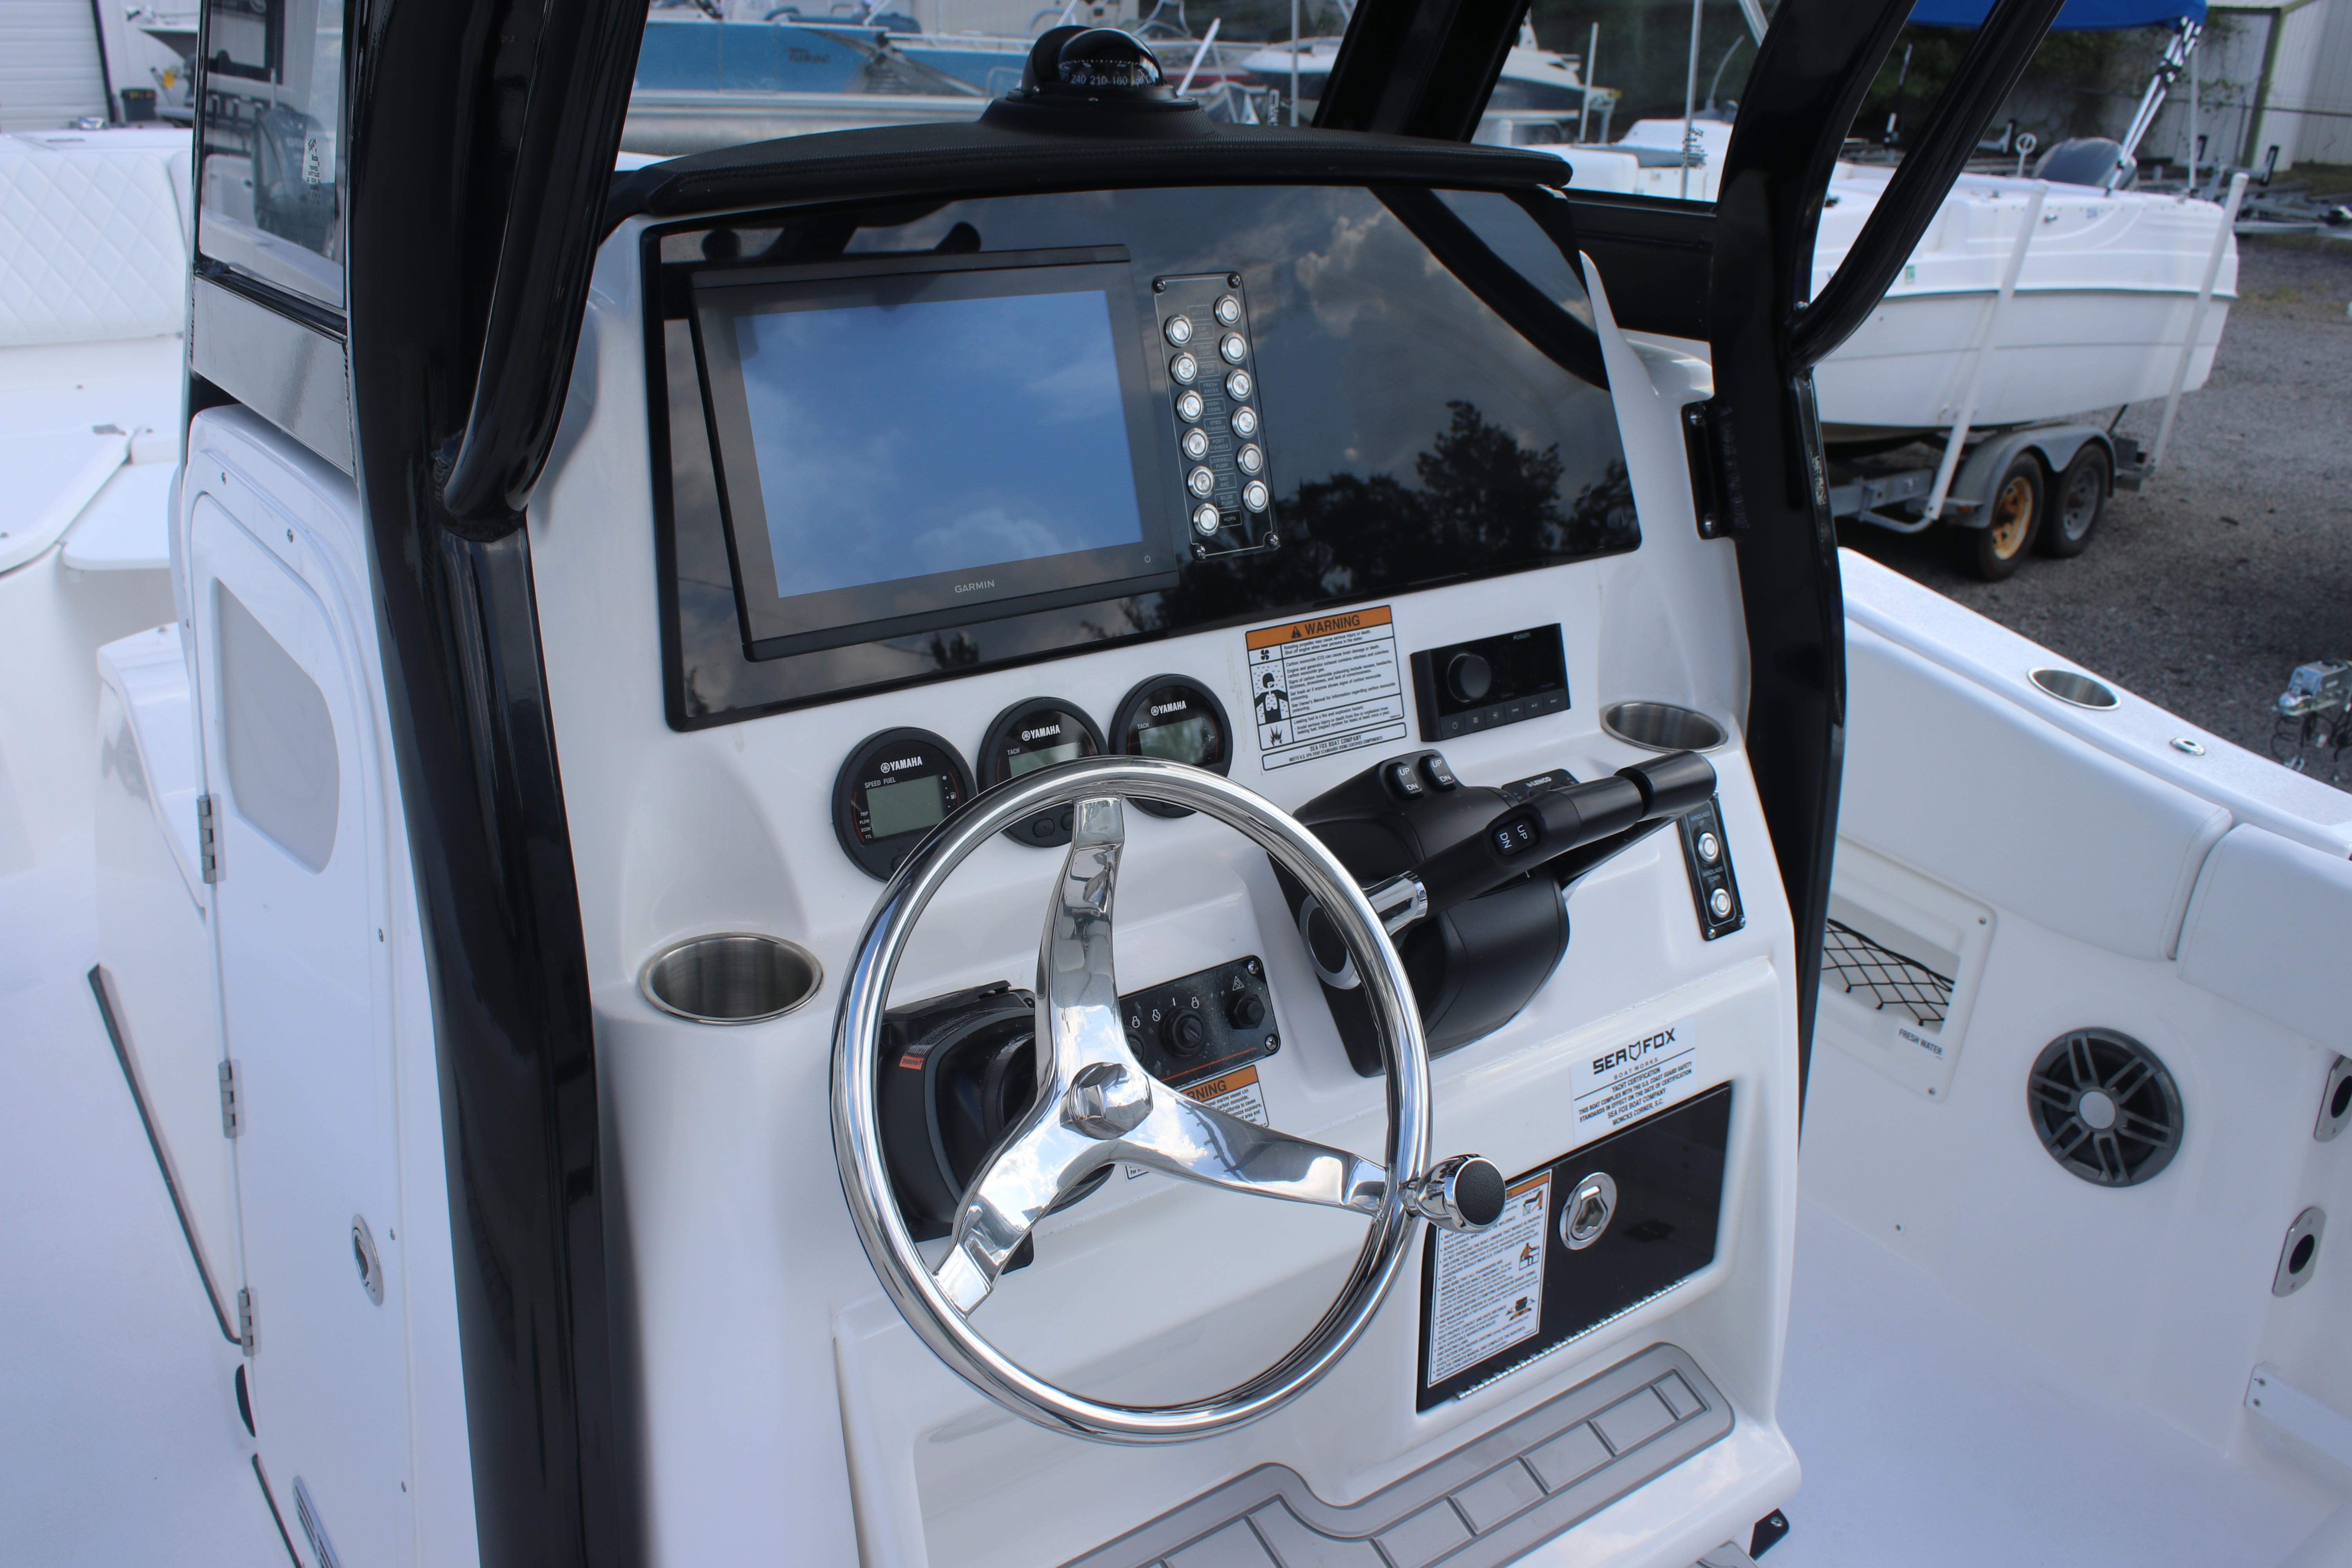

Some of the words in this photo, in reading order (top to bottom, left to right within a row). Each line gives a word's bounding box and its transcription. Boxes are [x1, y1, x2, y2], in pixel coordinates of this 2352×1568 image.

[1071, 74, 1086, 85] 240
[1090, 76, 1107, 85] 210
[1112, 76, 1128, 85] 180
[955, 580, 995, 593] GARMIN
[1305, 614, 1360, 635] WARNING
[1158, 701, 1187, 714] YAMAHA
[1030, 724, 1060, 739] YAMAHA
[1340, 735, 1361, 744] COMPANY
[890, 756, 922, 771] YAMAHA
[1432, 759, 1442, 768] UP
[1399, 767, 1410, 776] UP
[864, 780, 881, 789] SPEED
[1531, 777, 1552, 786] LENCO
[1690, 811, 1710, 821] WINDLASS
[1517, 824, 1528, 839] UP
[1499, 832, 1512, 848] DN
[1702, 866, 1723, 877] WINDLASS
[1708, 874, 1720, 883] DOWN
[1899, 1029, 1919, 1044] FRESH
[1920, 1039, 1942, 1055] WATER
[1592, 1048, 1627, 1075] SEA
[1643, 1027, 1675, 1054] FOX
[1614, 1068, 1633, 1080] BOAT
[1634, 1057, 1659, 1073] WORKS
[1612, 1081, 1626, 1092] YACHT
[1628, 1067, 1660, 1085] CERTIFICATION
[1187, 1080, 1227, 1101] RNING
[1579, 1106, 1589, 1114] THIS
[1589, 1101, 1600, 1111] BOAT
[1601, 1092, 1621, 1105] COMPLIES
[1622, 1087, 1632, 1096] WITH
[1650, 1074, 1662, 1083] COAST
[1663, 1067, 1677, 1078] GUARD
[1677, 1061, 1691, 1071] SAFETY
[1230, 1095, 1249, 1105] monoxide,
[1579, 1107, 1605, 1122] STANDARDS
[1611, 1097, 1627, 1108] EFFECT
[1644, 1085, 1654, 1094] DATE
[1662, 1069, 1691, 1085] CERTIFICATION
[1608, 1109, 1618, 1119] SEA
[1618, 1105, 1628, 1114] FOX
[1629, 1098, 1641, 1109] BOAT
[1642, 1088, 1666, 1103] COMPANY
[1613, 1112, 1633, 1126] MONCKS
